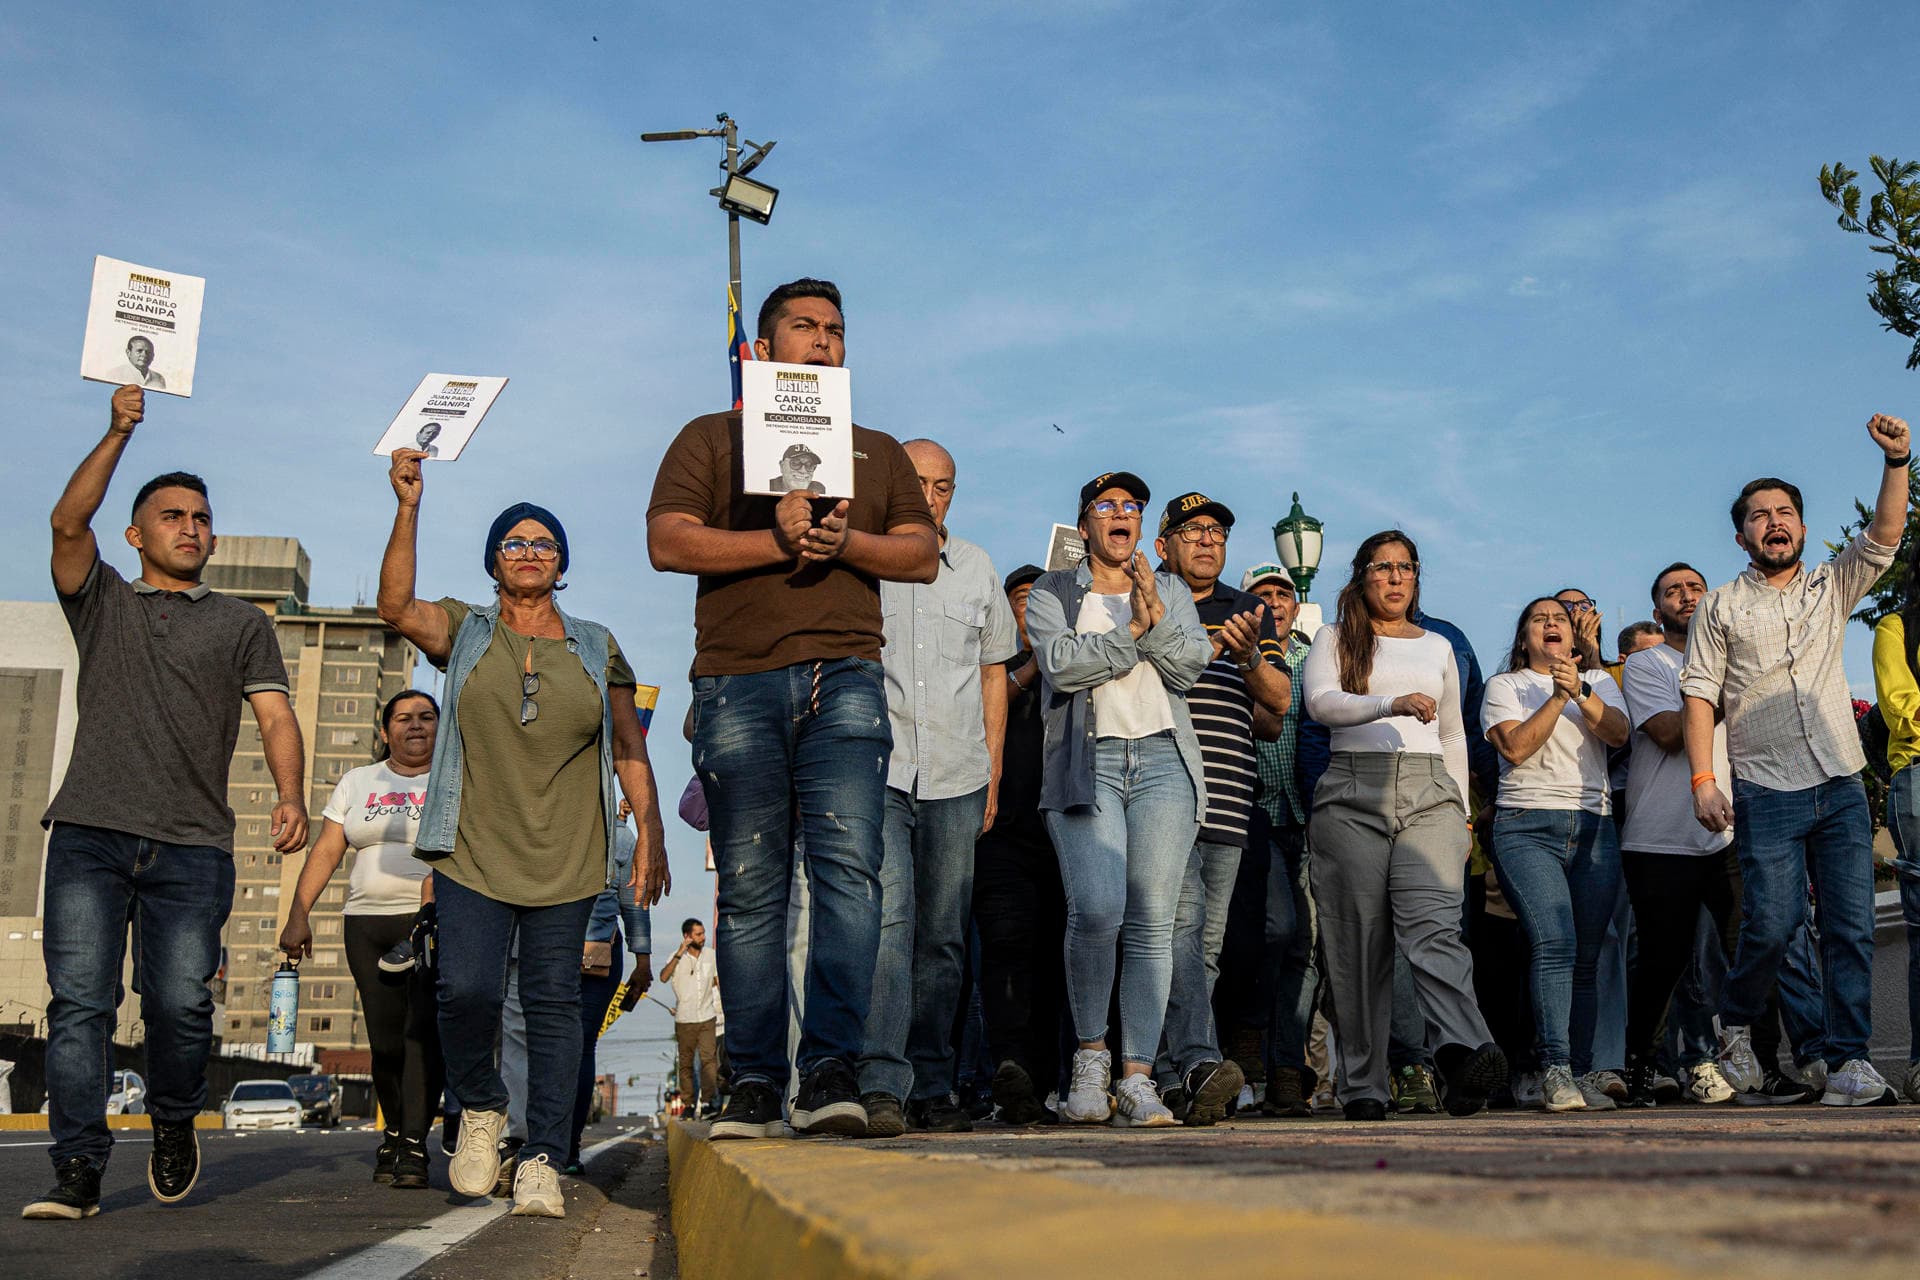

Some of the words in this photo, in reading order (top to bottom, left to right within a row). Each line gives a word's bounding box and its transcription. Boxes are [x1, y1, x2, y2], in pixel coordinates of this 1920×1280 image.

[130, 273, 171, 288] PRIMERO
[129, 280, 171, 298] JUSTICIA
[118, 291, 144, 302] JUAN
[146, 297, 177, 309] PABLO
[117, 299, 176, 318] GUANIPA
[777, 371, 818, 381] PRIMERO
[776, 379, 819, 393] JUSTICIA
[427, 399, 471, 408] GUANIPA
[774, 394, 822, 405] CARLOS
[779, 403, 817, 414] CAÑAS
[769, 414, 828, 424] COLOMBIANO
